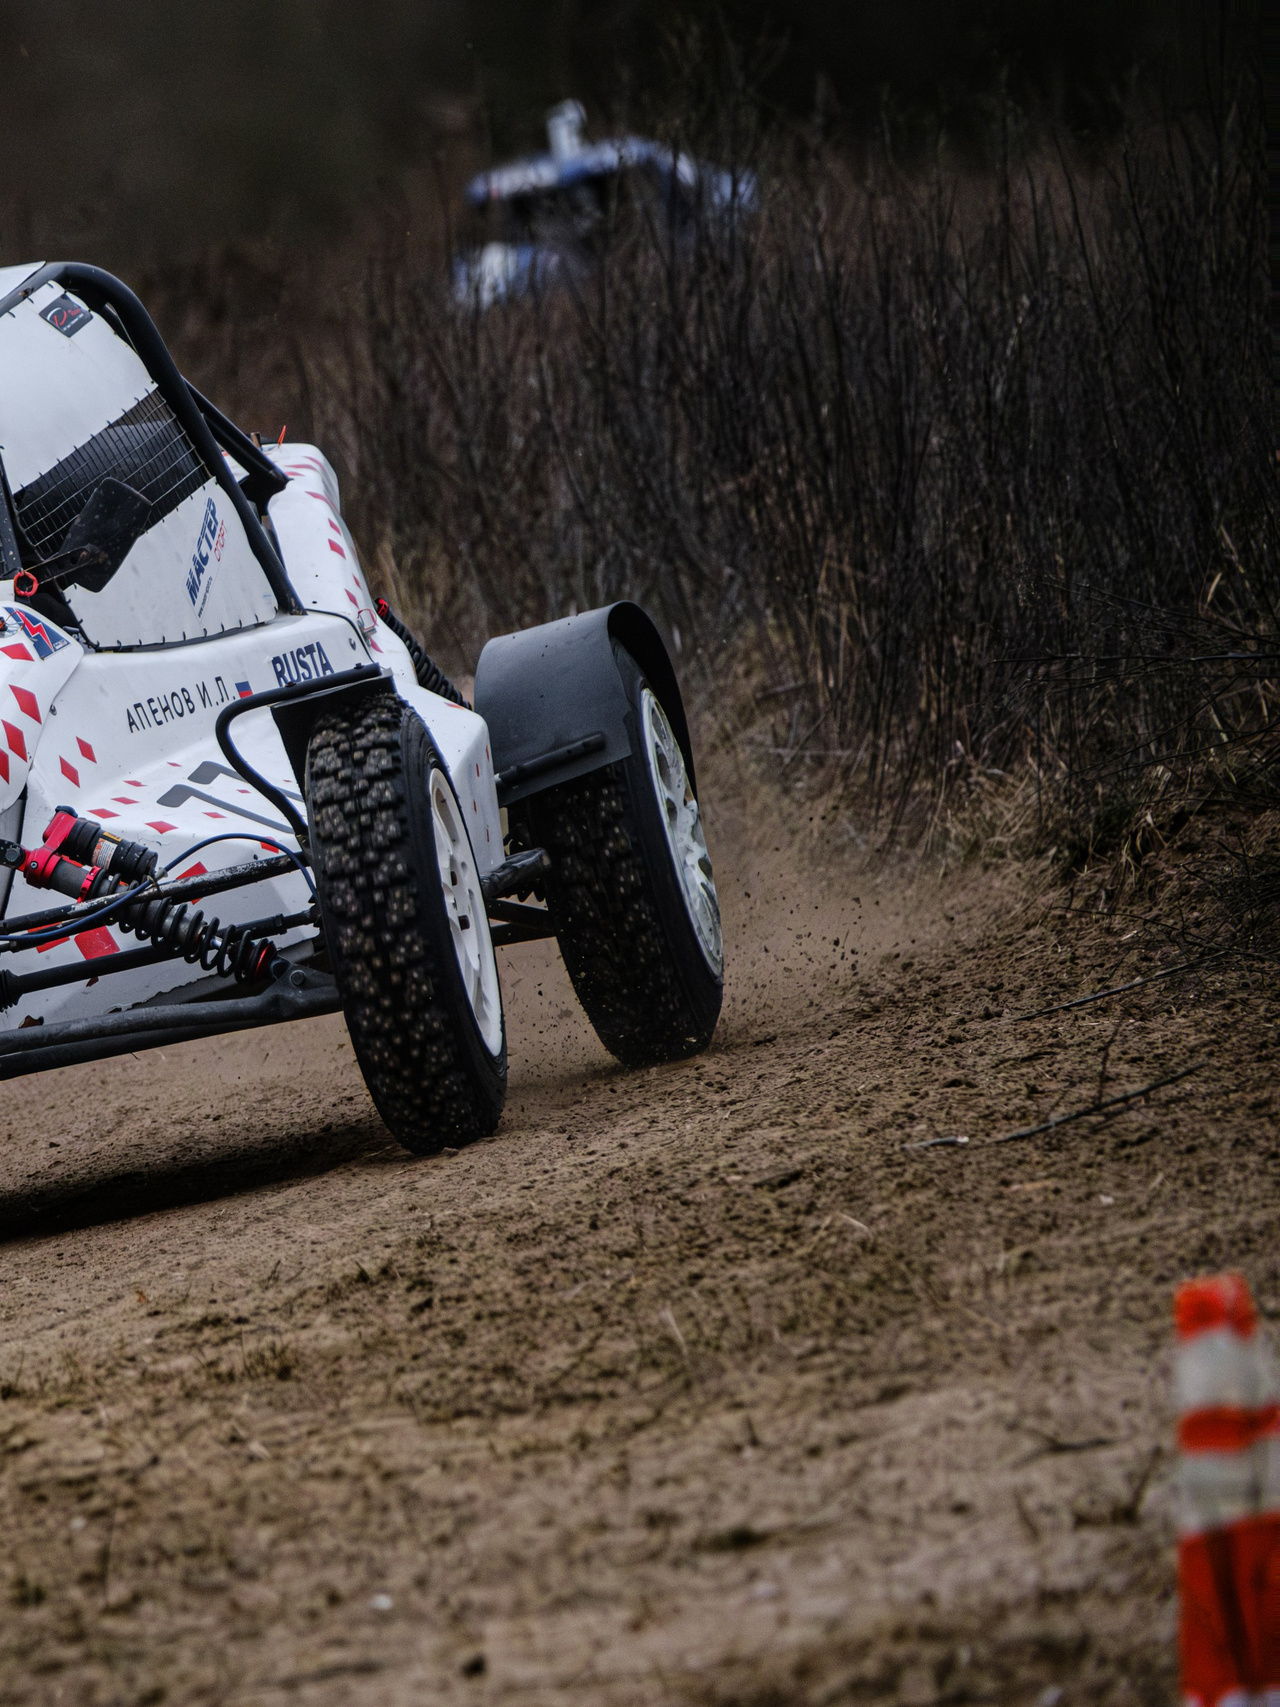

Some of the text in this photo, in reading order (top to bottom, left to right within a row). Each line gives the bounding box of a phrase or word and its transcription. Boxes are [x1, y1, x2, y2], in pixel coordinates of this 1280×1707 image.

[186, 497, 219, 606] МАСТЕР
[271, 641, 335, 688] RUSTA
[126, 687, 196, 734] АПЕНОВ
